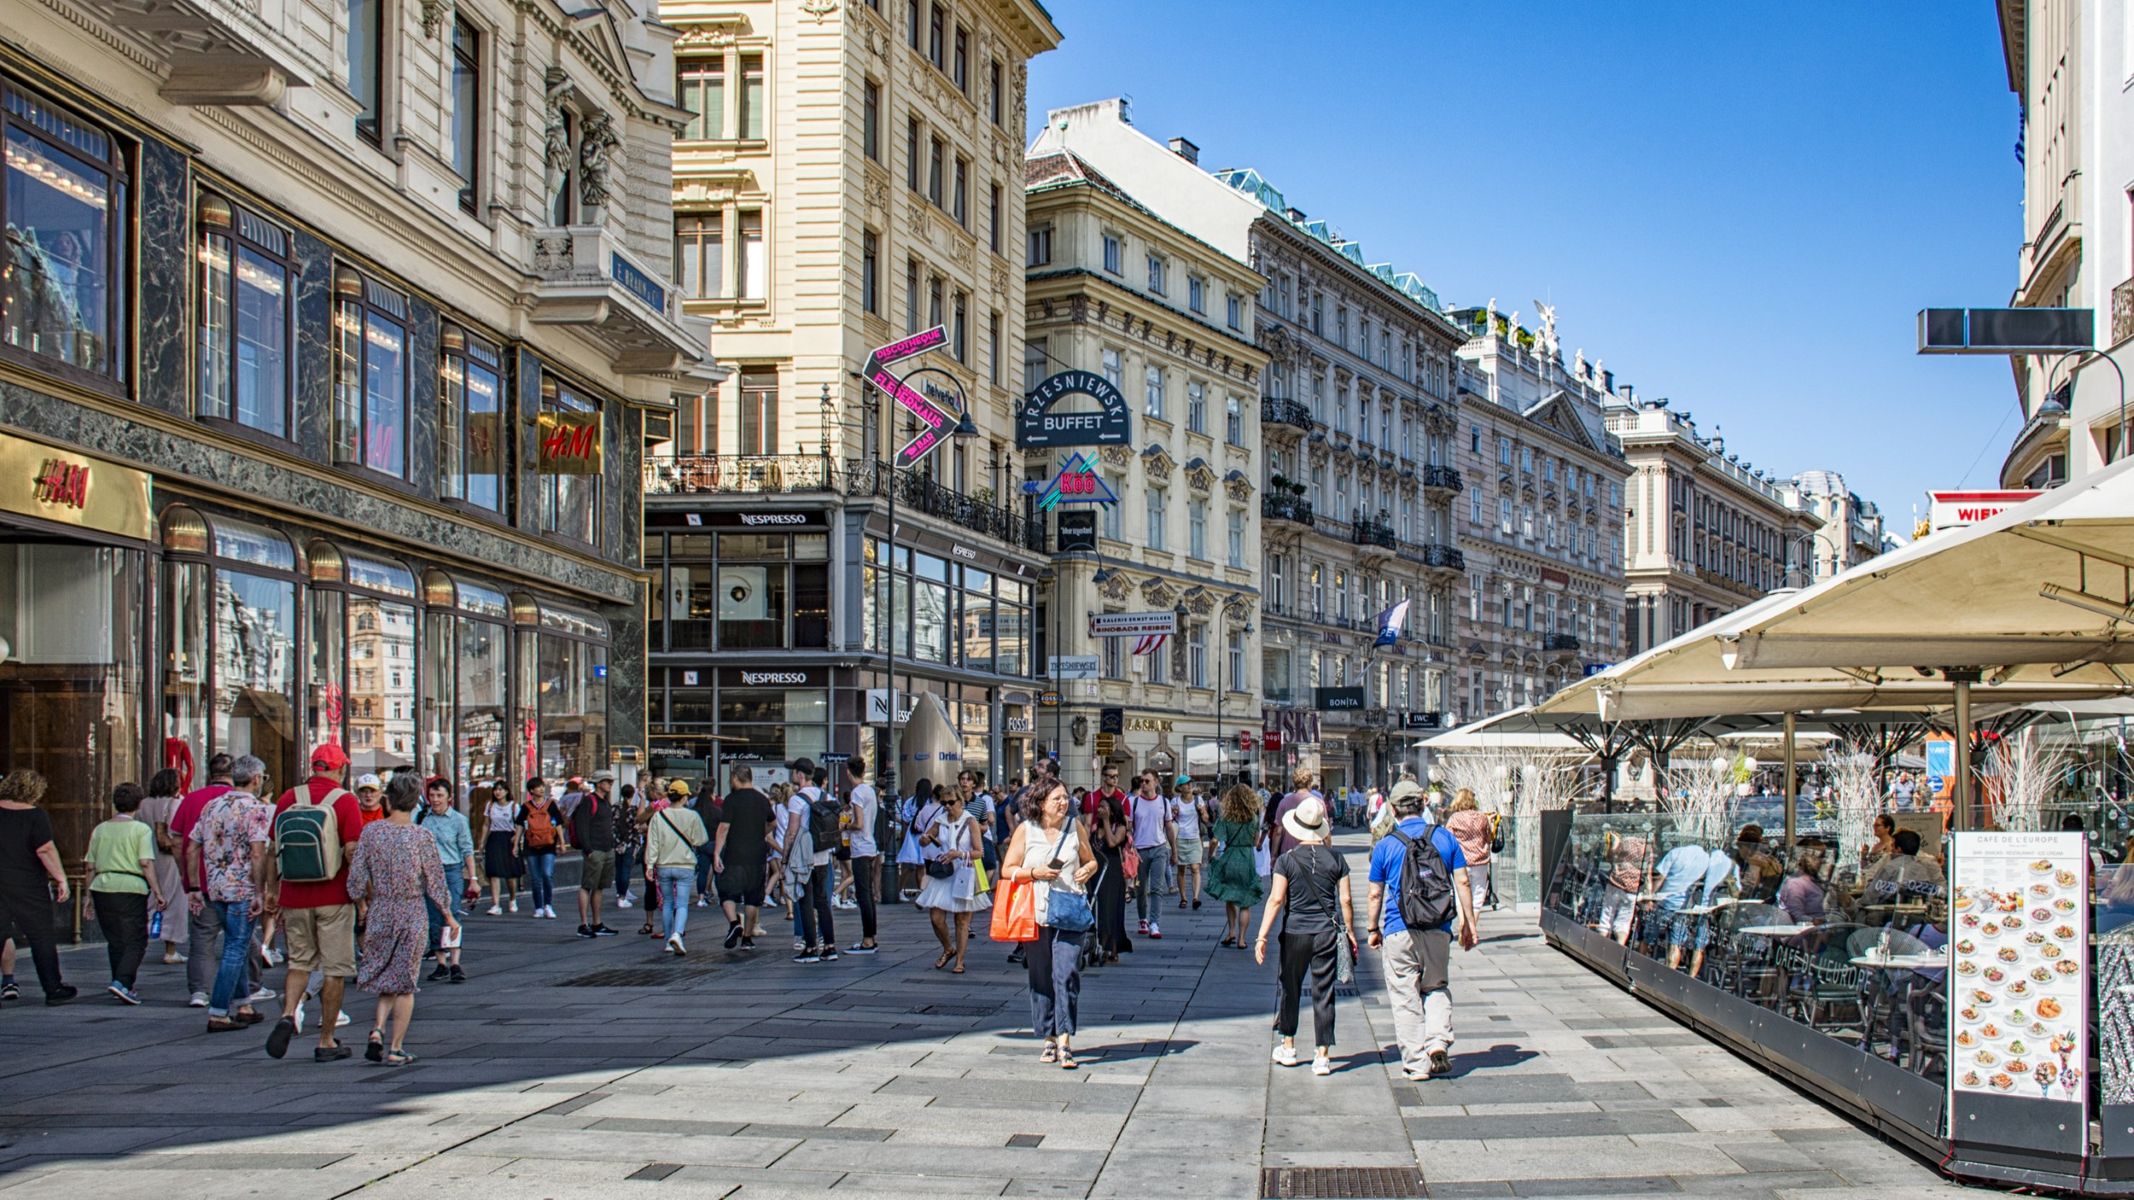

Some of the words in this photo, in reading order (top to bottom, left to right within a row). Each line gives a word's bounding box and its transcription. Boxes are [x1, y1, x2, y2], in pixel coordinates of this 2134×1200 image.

[876, 329, 940, 359] DISCOTHEQUE
[1044, 415, 1103, 430] BUFFET
[543, 425, 595, 460] H&M
[915, 432, 936, 454] BAR
[740, 513, 806, 525] NESPRESSO
[741, 671, 807, 685] NESPRESSO
[1329, 697, 1358, 707] BONITA
